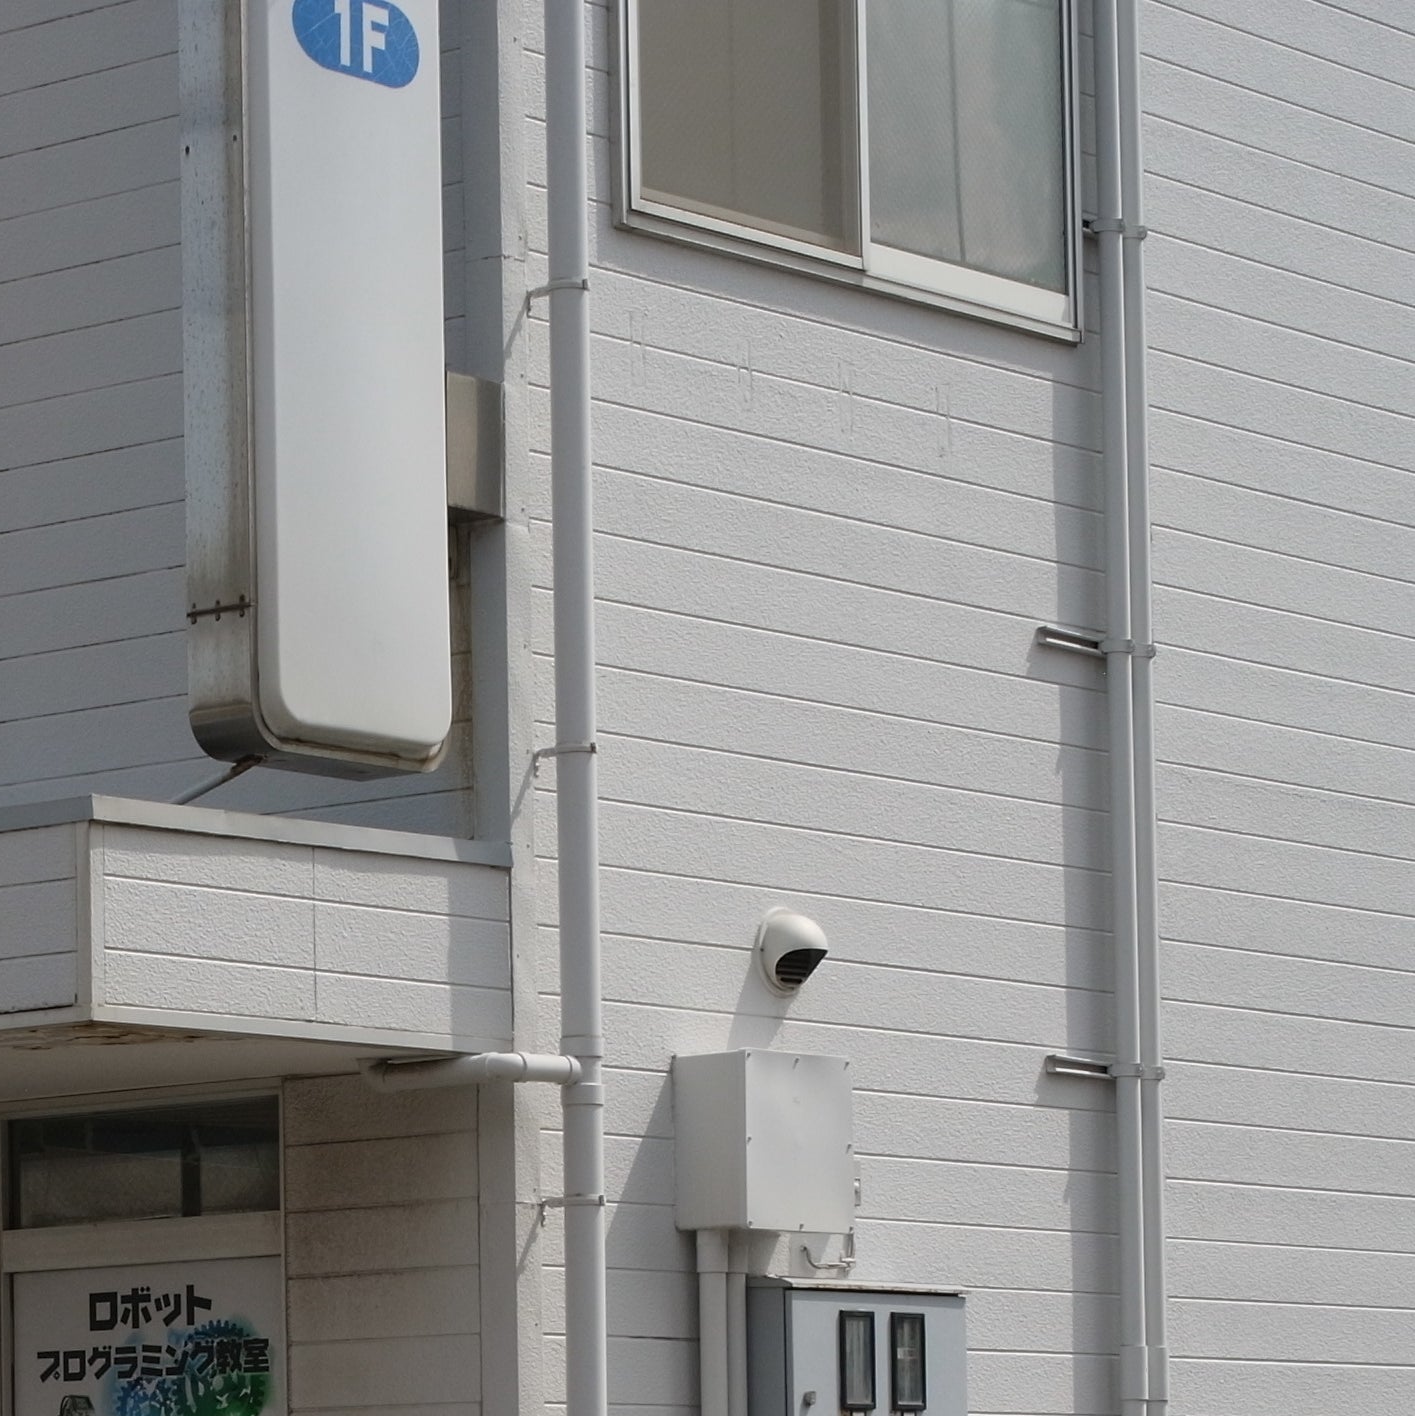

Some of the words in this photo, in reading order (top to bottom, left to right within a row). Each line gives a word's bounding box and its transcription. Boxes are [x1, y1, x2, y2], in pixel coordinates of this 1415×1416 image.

[334, 0, 389, 73] 1F
[89, 1284, 212, 1332] ロボット
[36, 1337, 270, 1383] プログラミング教室
